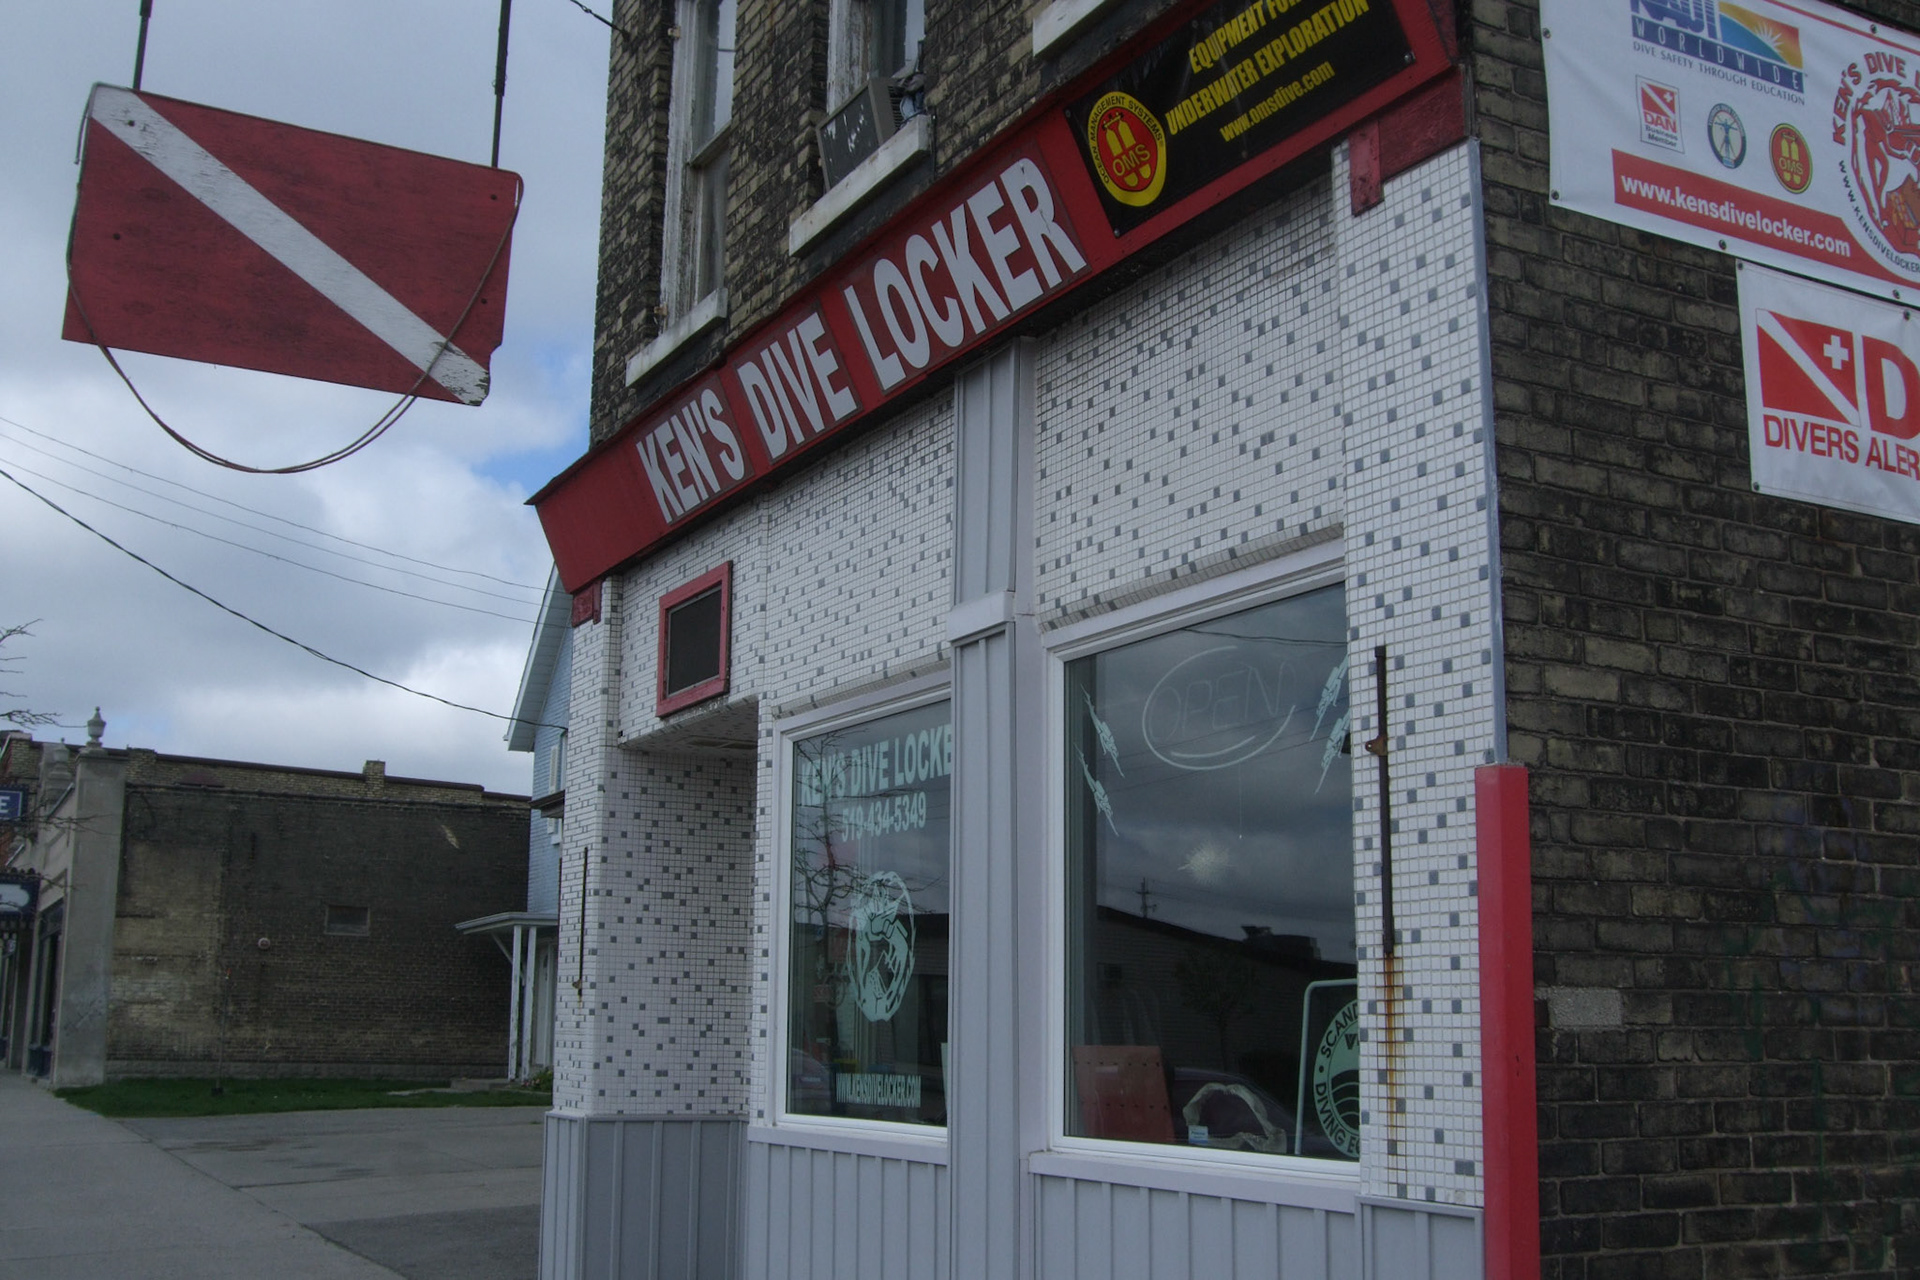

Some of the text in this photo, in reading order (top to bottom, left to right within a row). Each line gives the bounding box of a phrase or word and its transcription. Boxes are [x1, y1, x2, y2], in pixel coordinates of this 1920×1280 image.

[1165, 0, 1370, 136] UNDERWATER EXPLORATION
[1189, 1, 1267, 74] EQUIPMENT
[1219, 61, 1336, 142] www.omsdive.com
[1633, 41, 1806, 106] DIVE SAFETY THROUGH EDUCATION
[1832, 51, 1907, 146] KEN'S DIVE
[1090, 95, 1126, 142] MANAGEMENT
[1128, 100, 1163, 141] SYSTEMS
[1643, 109, 1678, 134] DAN
[1645, 124, 1679, 141] Business
[1647, 133, 1677, 147] Member
[1113, 144, 1151, 176] OMS
[1778, 155, 1805, 177] OMS
[1620, 174, 1851, 258] www.kensdivelocker.com
[636, 157, 1088, 524] KEN'S DIVE LOCKER
[1763, 414, 1860, 464] DIVERS
[1147, 661, 1297, 745] OPEN
[801, 751, 846, 806] KEN'S
[850, 739, 889, 796] DIVE
[841, 791, 927, 843] 519-434-5349
[1315, 1083, 1347, 1147] DIVING
